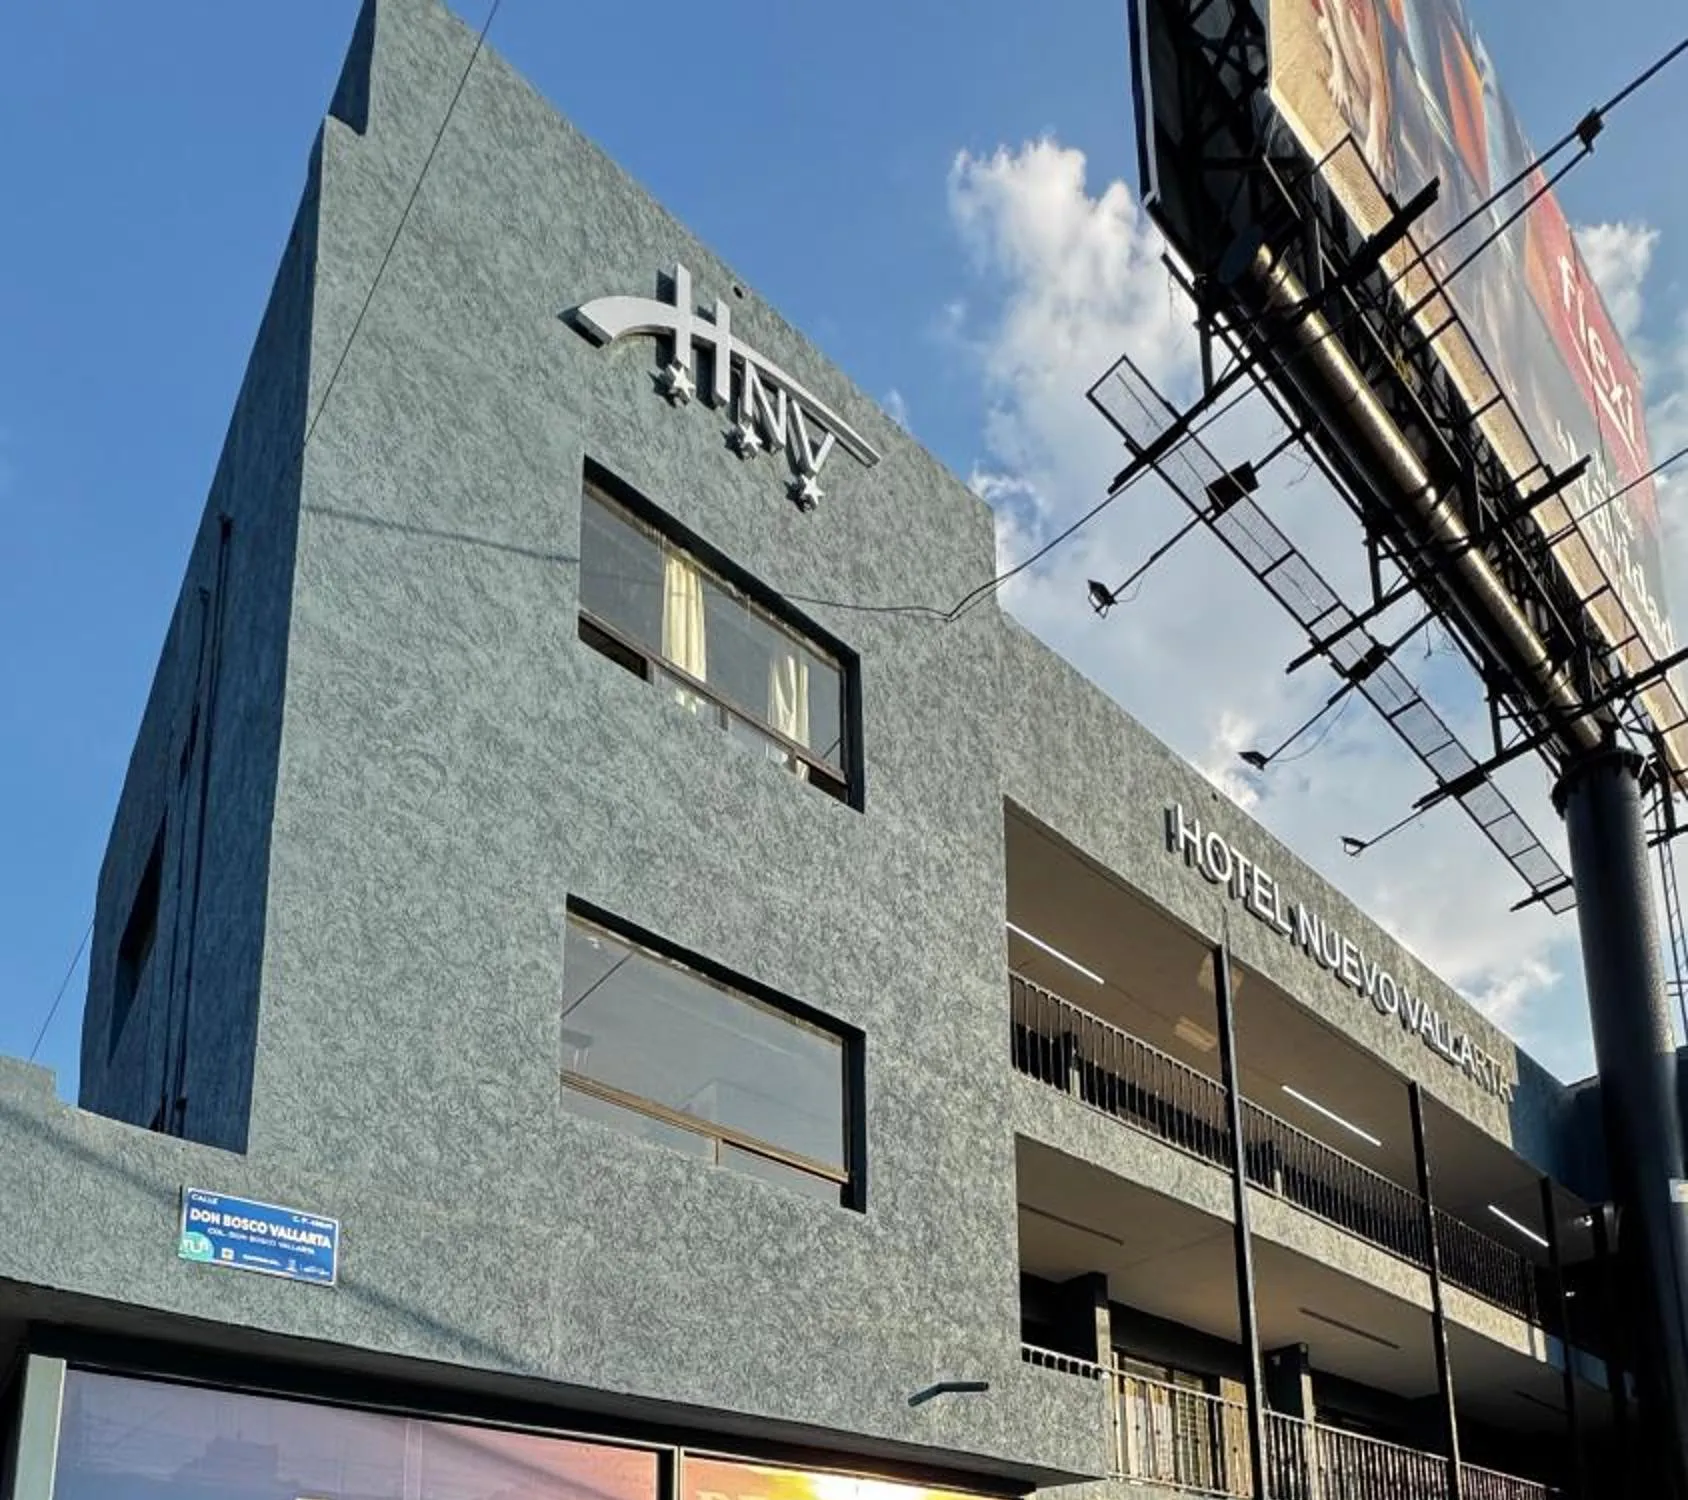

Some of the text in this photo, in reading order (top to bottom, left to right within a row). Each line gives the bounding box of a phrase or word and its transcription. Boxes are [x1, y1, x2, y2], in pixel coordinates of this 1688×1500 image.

[1174, 803, 1514, 1102] HOTEL NUEVO VALLARTA
[190, 1207, 221, 1225] DON
[223, 1213, 267, 1235] BOSCO
[269, 1222, 332, 1249] VALLARTA
